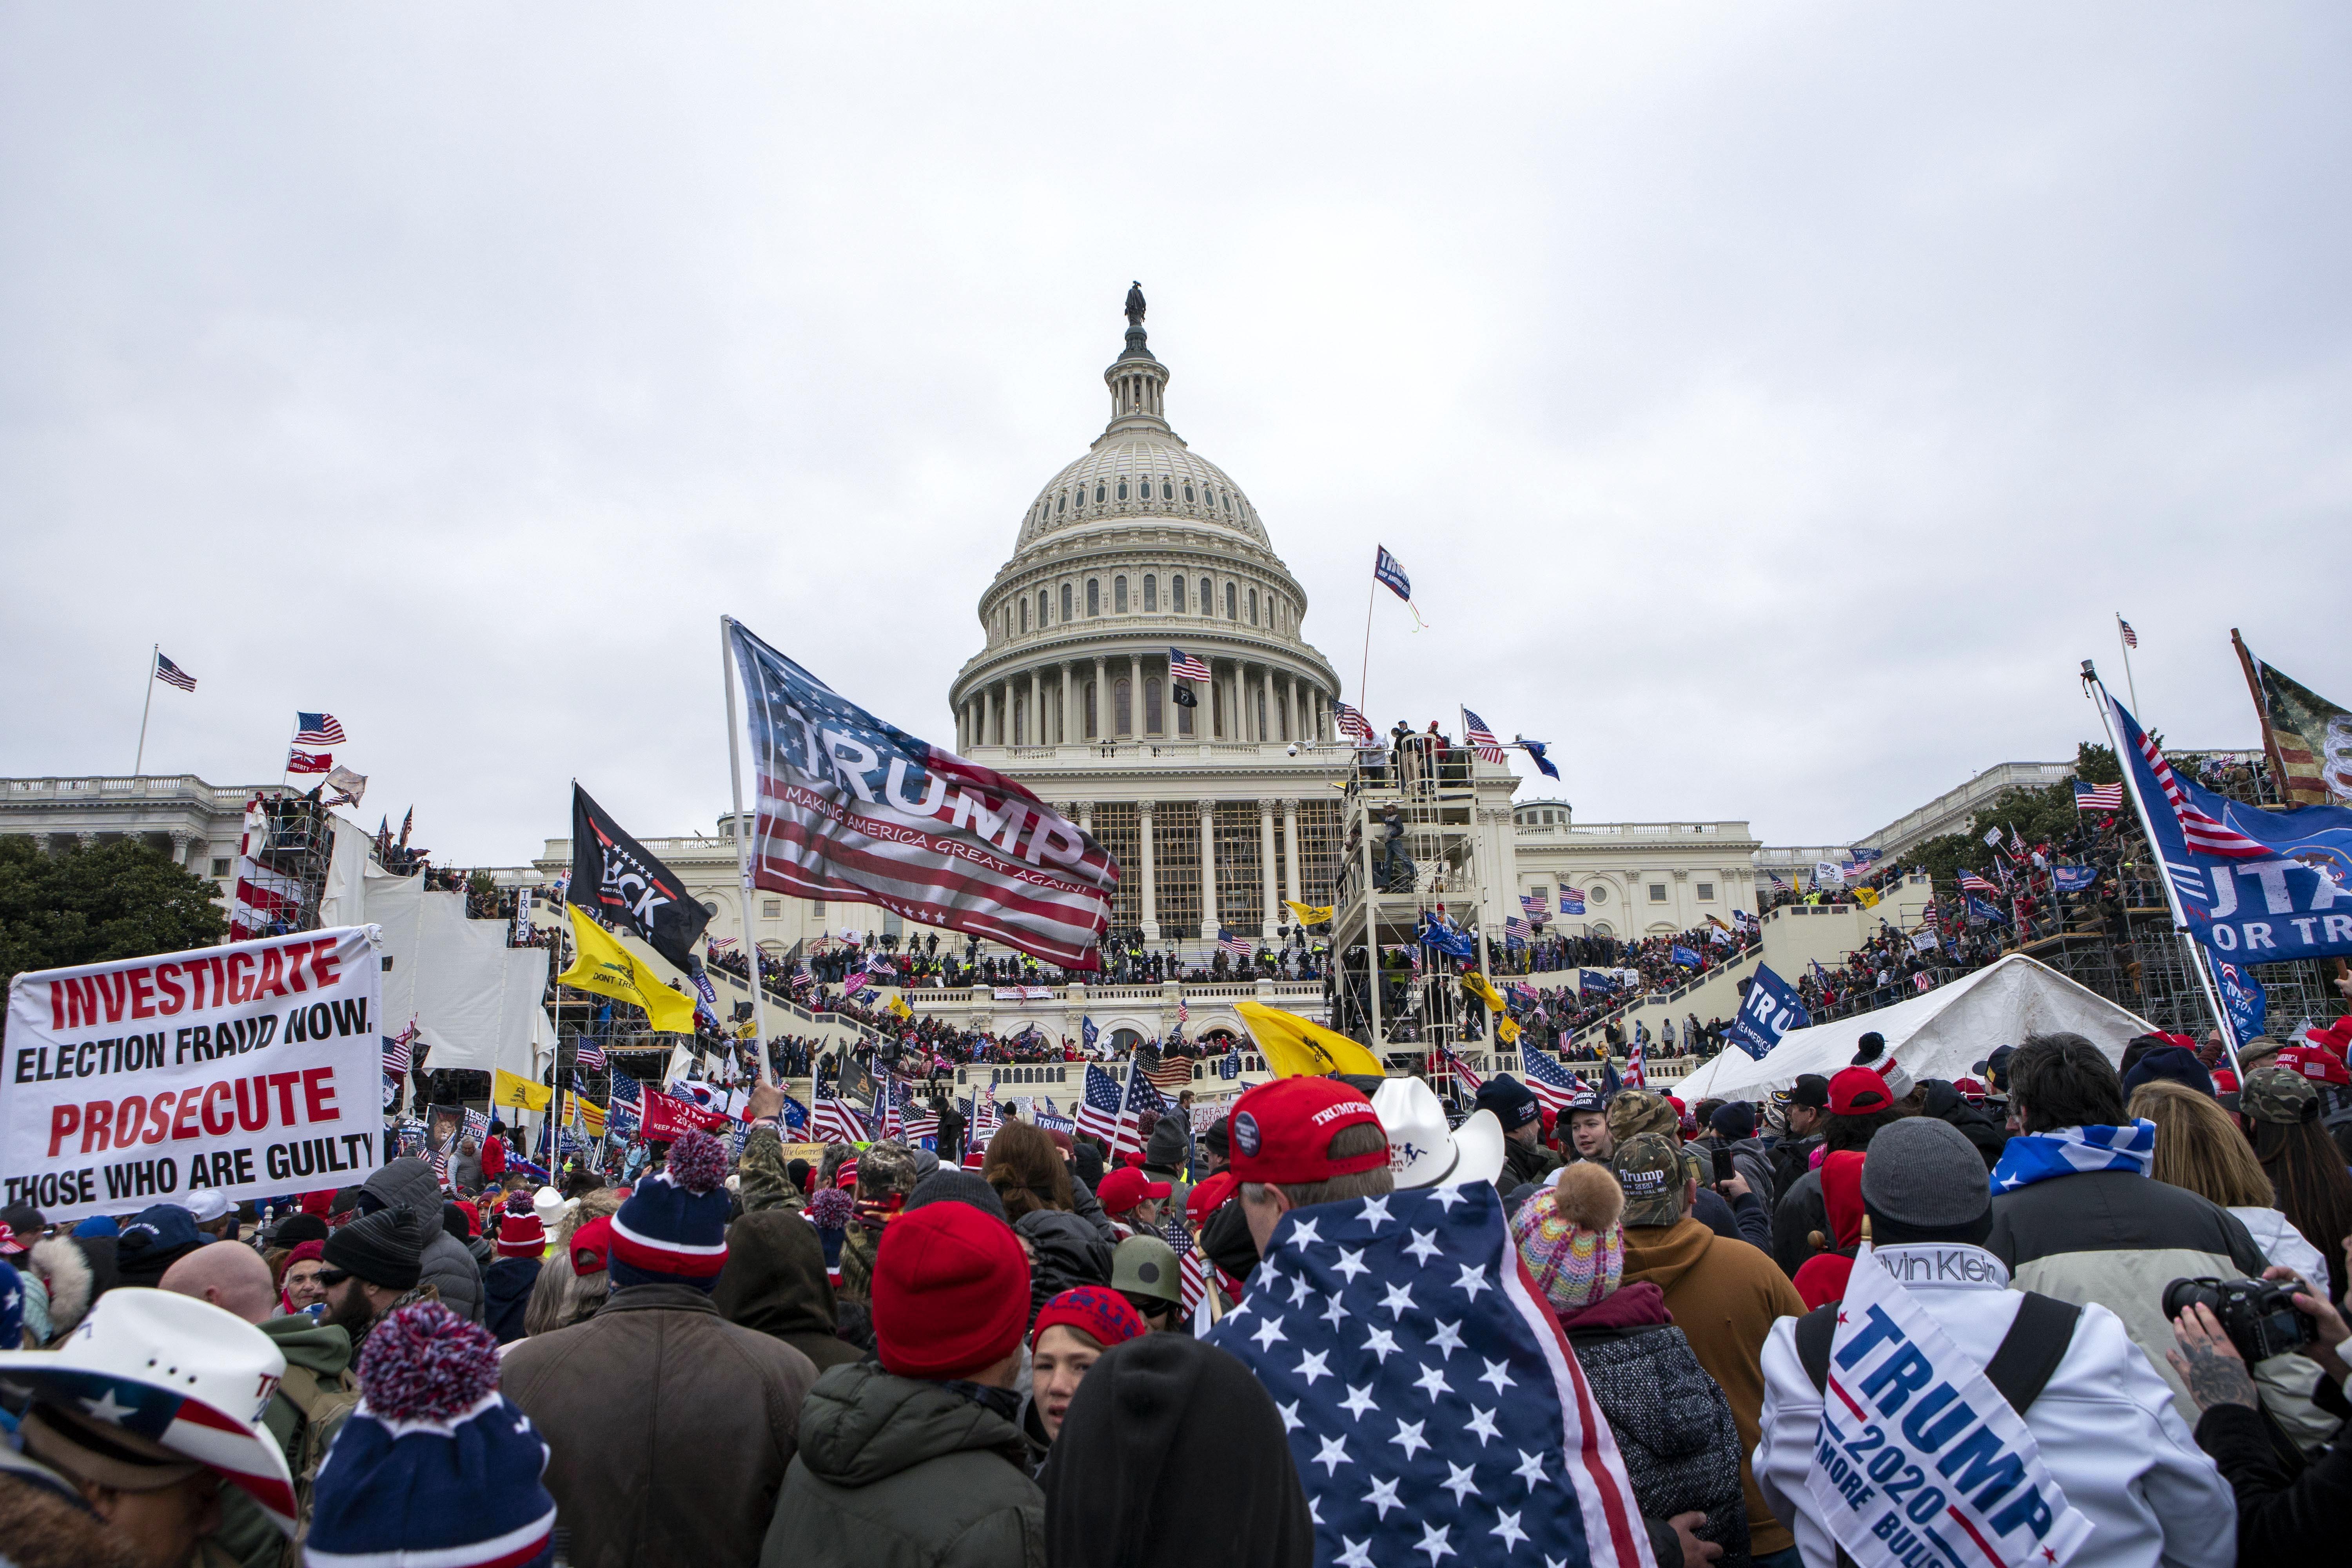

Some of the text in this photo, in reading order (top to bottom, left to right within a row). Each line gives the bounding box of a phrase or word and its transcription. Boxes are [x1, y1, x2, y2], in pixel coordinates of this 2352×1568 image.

[1378, 570, 1387, 578] KEEP
[1388, 574, 1402, 588] AMERICA
[1381, 552, 1410, 583] TRUM
[290, 763, 310, 772] LIBERTY
[786, 704, 1085, 866] TRUMP
[786, 786, 1087, 894] MAKING AMERICA GREAT AGAIN!
[602, 859, 670, 927] UCK
[518, 891, 528, 940] TRUMP
[1439, 942, 1458, 955] AMERICA
[1914, 931, 1935, 942] DEFUND
[2211, 922, 2276, 950] OR
[1678, 948, 1699, 959] TRUMP
[50, 937, 341, 1030] INVESTIGATE
[593, 972, 639, 995] DONT TRE
[698, 973, 714, 1001] TRUMP
[1584, 982, 1607, 991] LIBERTY
[1746, 982, 1794, 1038] TRU
[15, 997, 372, 1083] ELECTION FRAUD NOW.
[1744, 1029, 1770, 1051] AMERICA
[47, 1067, 341, 1157] PROSECUTE
[465, 1107, 493, 1125] JESUS
[658, 1096, 718, 1123] TRUM
[1517, 1101, 1534, 1113] Trump
[462, 1126, 486, 1138] TRUM
[1038, 1116, 1073, 1133] TRUMP
[782, 1147, 794, 1156] The
[4, 1132, 372, 1207] THOSE WHO ARE GUILTY
[1619, 1169, 1664, 1184] Trump
[142, 1223, 160, 1235] TRUMP
[1881, 1251, 1996, 1283] lvin Klein
[1835, 1303, 2052, 1541] TRUMP
[1815, 1445, 1876, 1512] MORE
[1843, 1425, 1946, 1526] 2020
